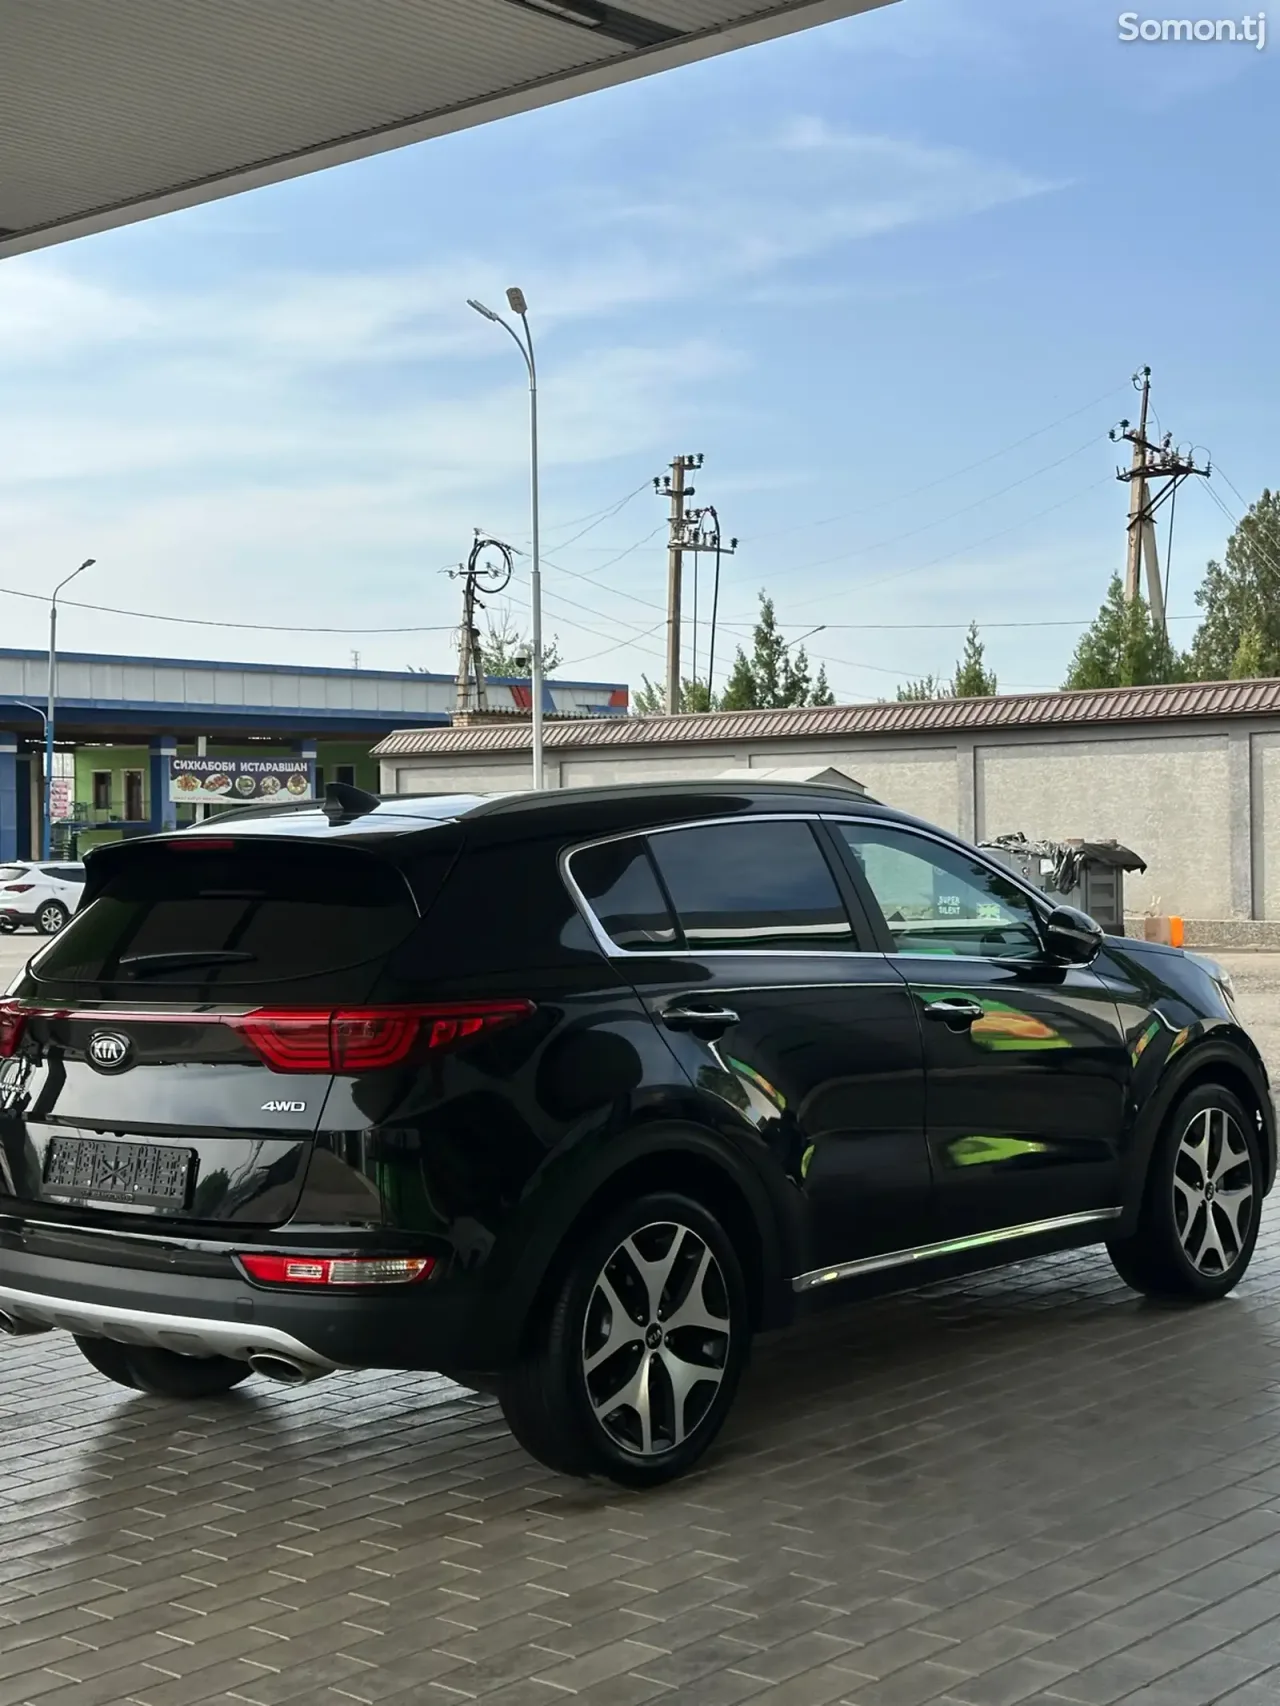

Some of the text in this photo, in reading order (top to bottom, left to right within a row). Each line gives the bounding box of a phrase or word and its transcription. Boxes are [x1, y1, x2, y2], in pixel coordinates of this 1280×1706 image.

[173, 760, 308, 772] СИХКАБОБИ ИСТАРАВШАН
[94, 1041, 118, 1059] KIA
[260, 1101, 306, 1112] 4WD
